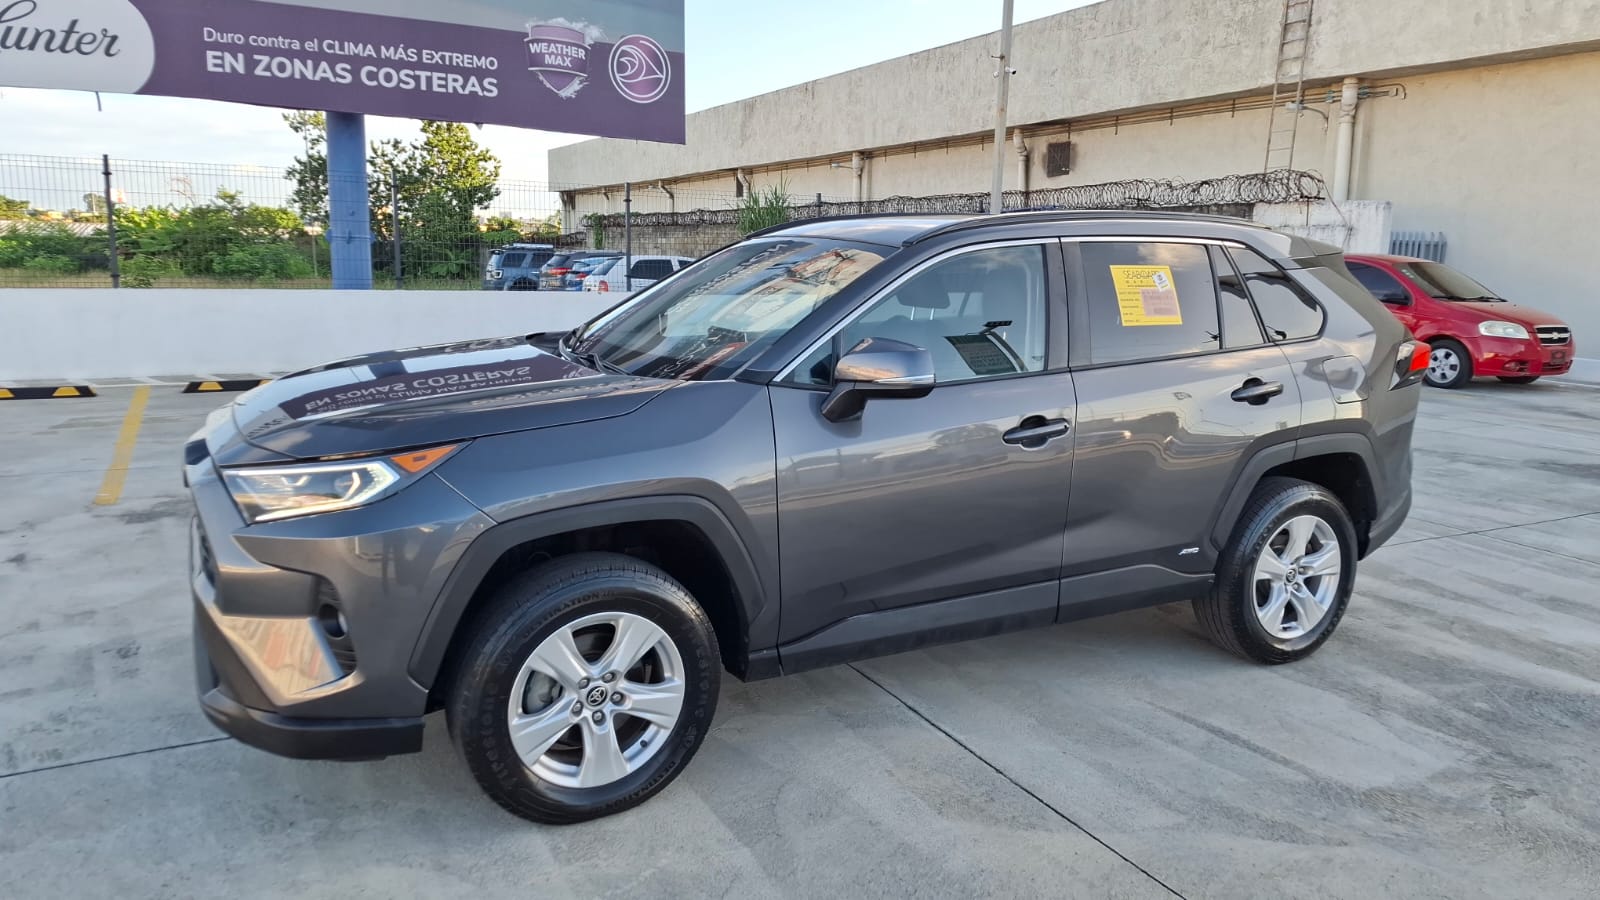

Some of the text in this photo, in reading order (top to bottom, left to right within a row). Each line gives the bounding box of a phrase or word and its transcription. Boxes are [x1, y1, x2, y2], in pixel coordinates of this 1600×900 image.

[0, 0, 120, 57] unter
[203, 26, 499, 70] Duro contra el CLIMA MÁS EXTREMO
[528, 42, 587, 60] WEATHER
[544, 54, 573, 68] MAX
[206, 50, 499, 97] EN ZONAS COSTERAS
